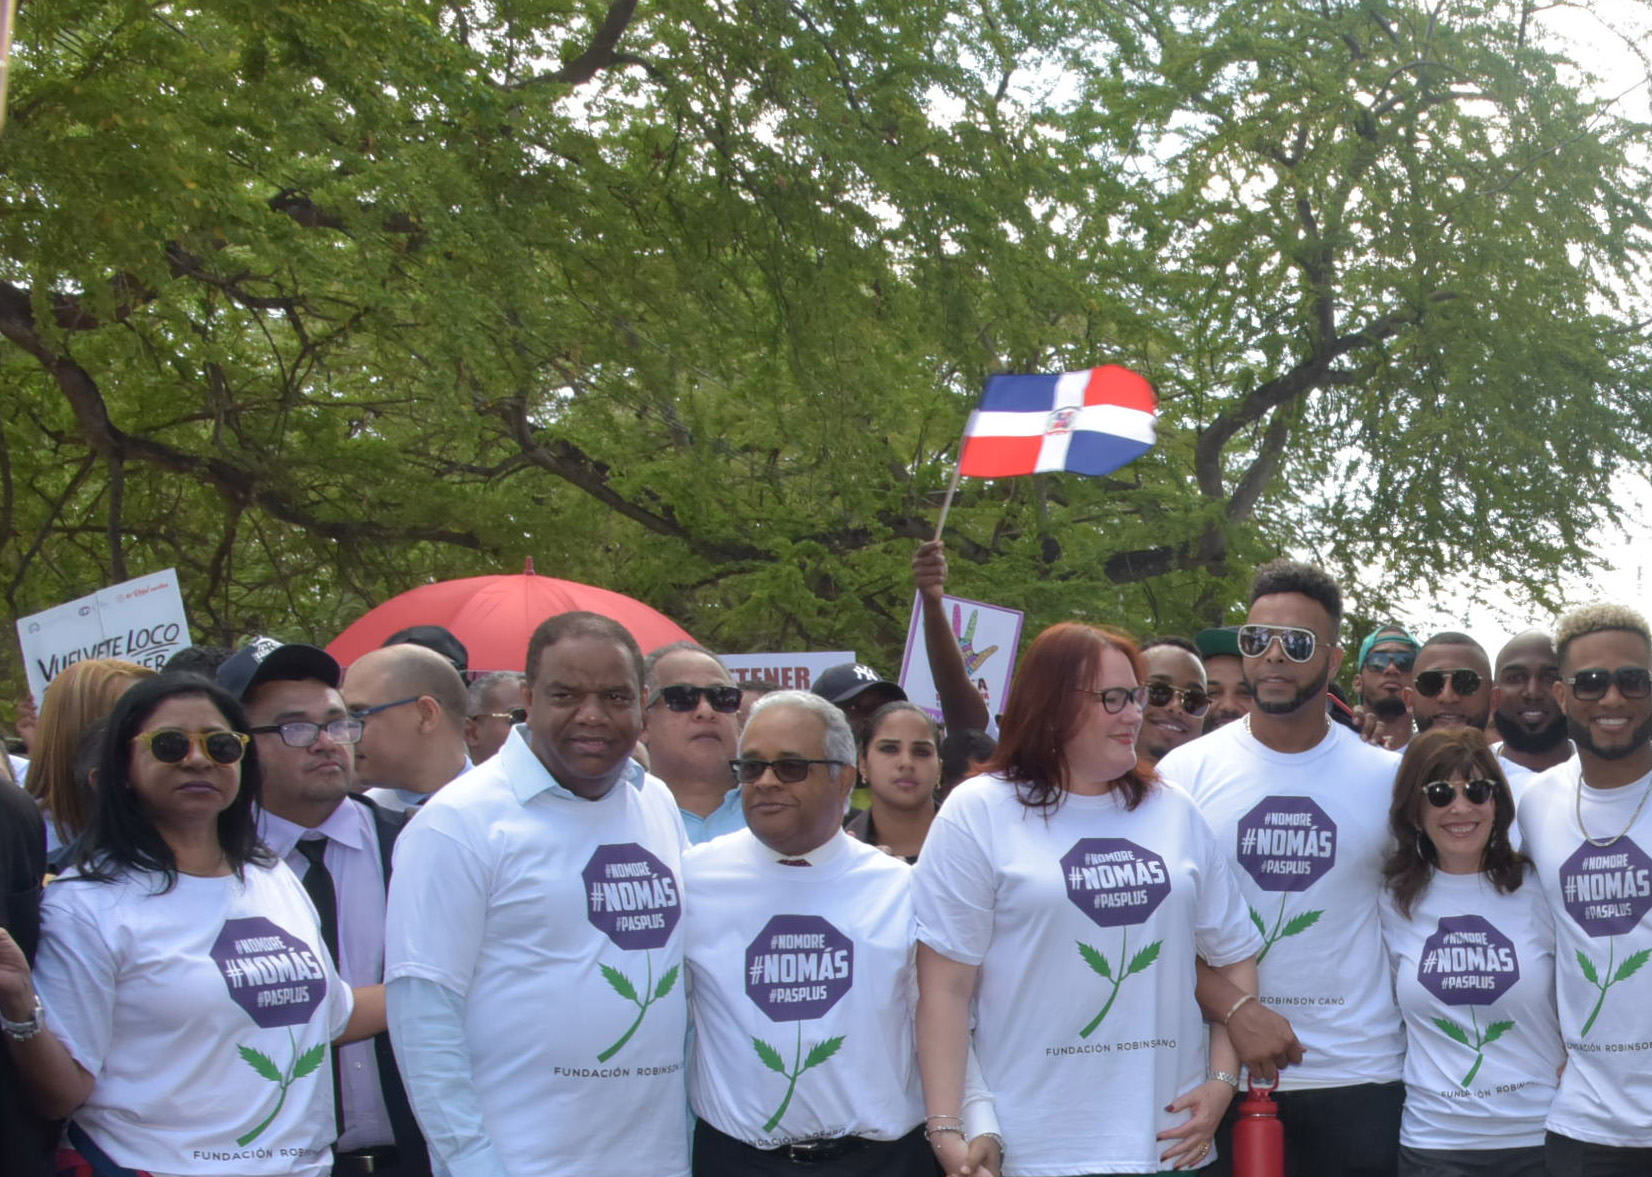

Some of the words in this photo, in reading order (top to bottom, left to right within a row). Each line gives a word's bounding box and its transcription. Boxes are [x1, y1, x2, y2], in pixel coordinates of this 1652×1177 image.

[127, 623, 179, 655] LOCO
[1265, 812, 1312, 827] #NOMORE
[1241, 825, 1332, 858] #NOMÁS
[1068, 859, 1165, 890] #NOMÁS
[1261, 860, 1311, 874] #PASPLUS
[591, 874, 678, 912] #NOMÁS
[1564, 865, 1650, 903] #NOMÁS
[1094, 890, 1148, 909] #PASPLUS
[616, 914, 665, 932] #PASPLUS
[771, 934, 825, 949] #NOMORE
[225, 947, 324, 988] #NOMÁS
[749, 947, 849, 985] #NOMÁS
[1423, 944, 1514, 973] #NOMÁS
[1441, 976, 1495, 990] #PASPLUS
[258, 986, 310, 1008] #PASPLUS
[769, 985, 827, 1003] #PASPLUS
[1260, 996, 1315, 1006] ROBINSON
[1046, 1043, 1111, 1057] FUNDACIÓN
[553, 1066, 630, 1079] FUNDACIÓN
[193, 1147, 273, 1162] FUNDACIÓN
